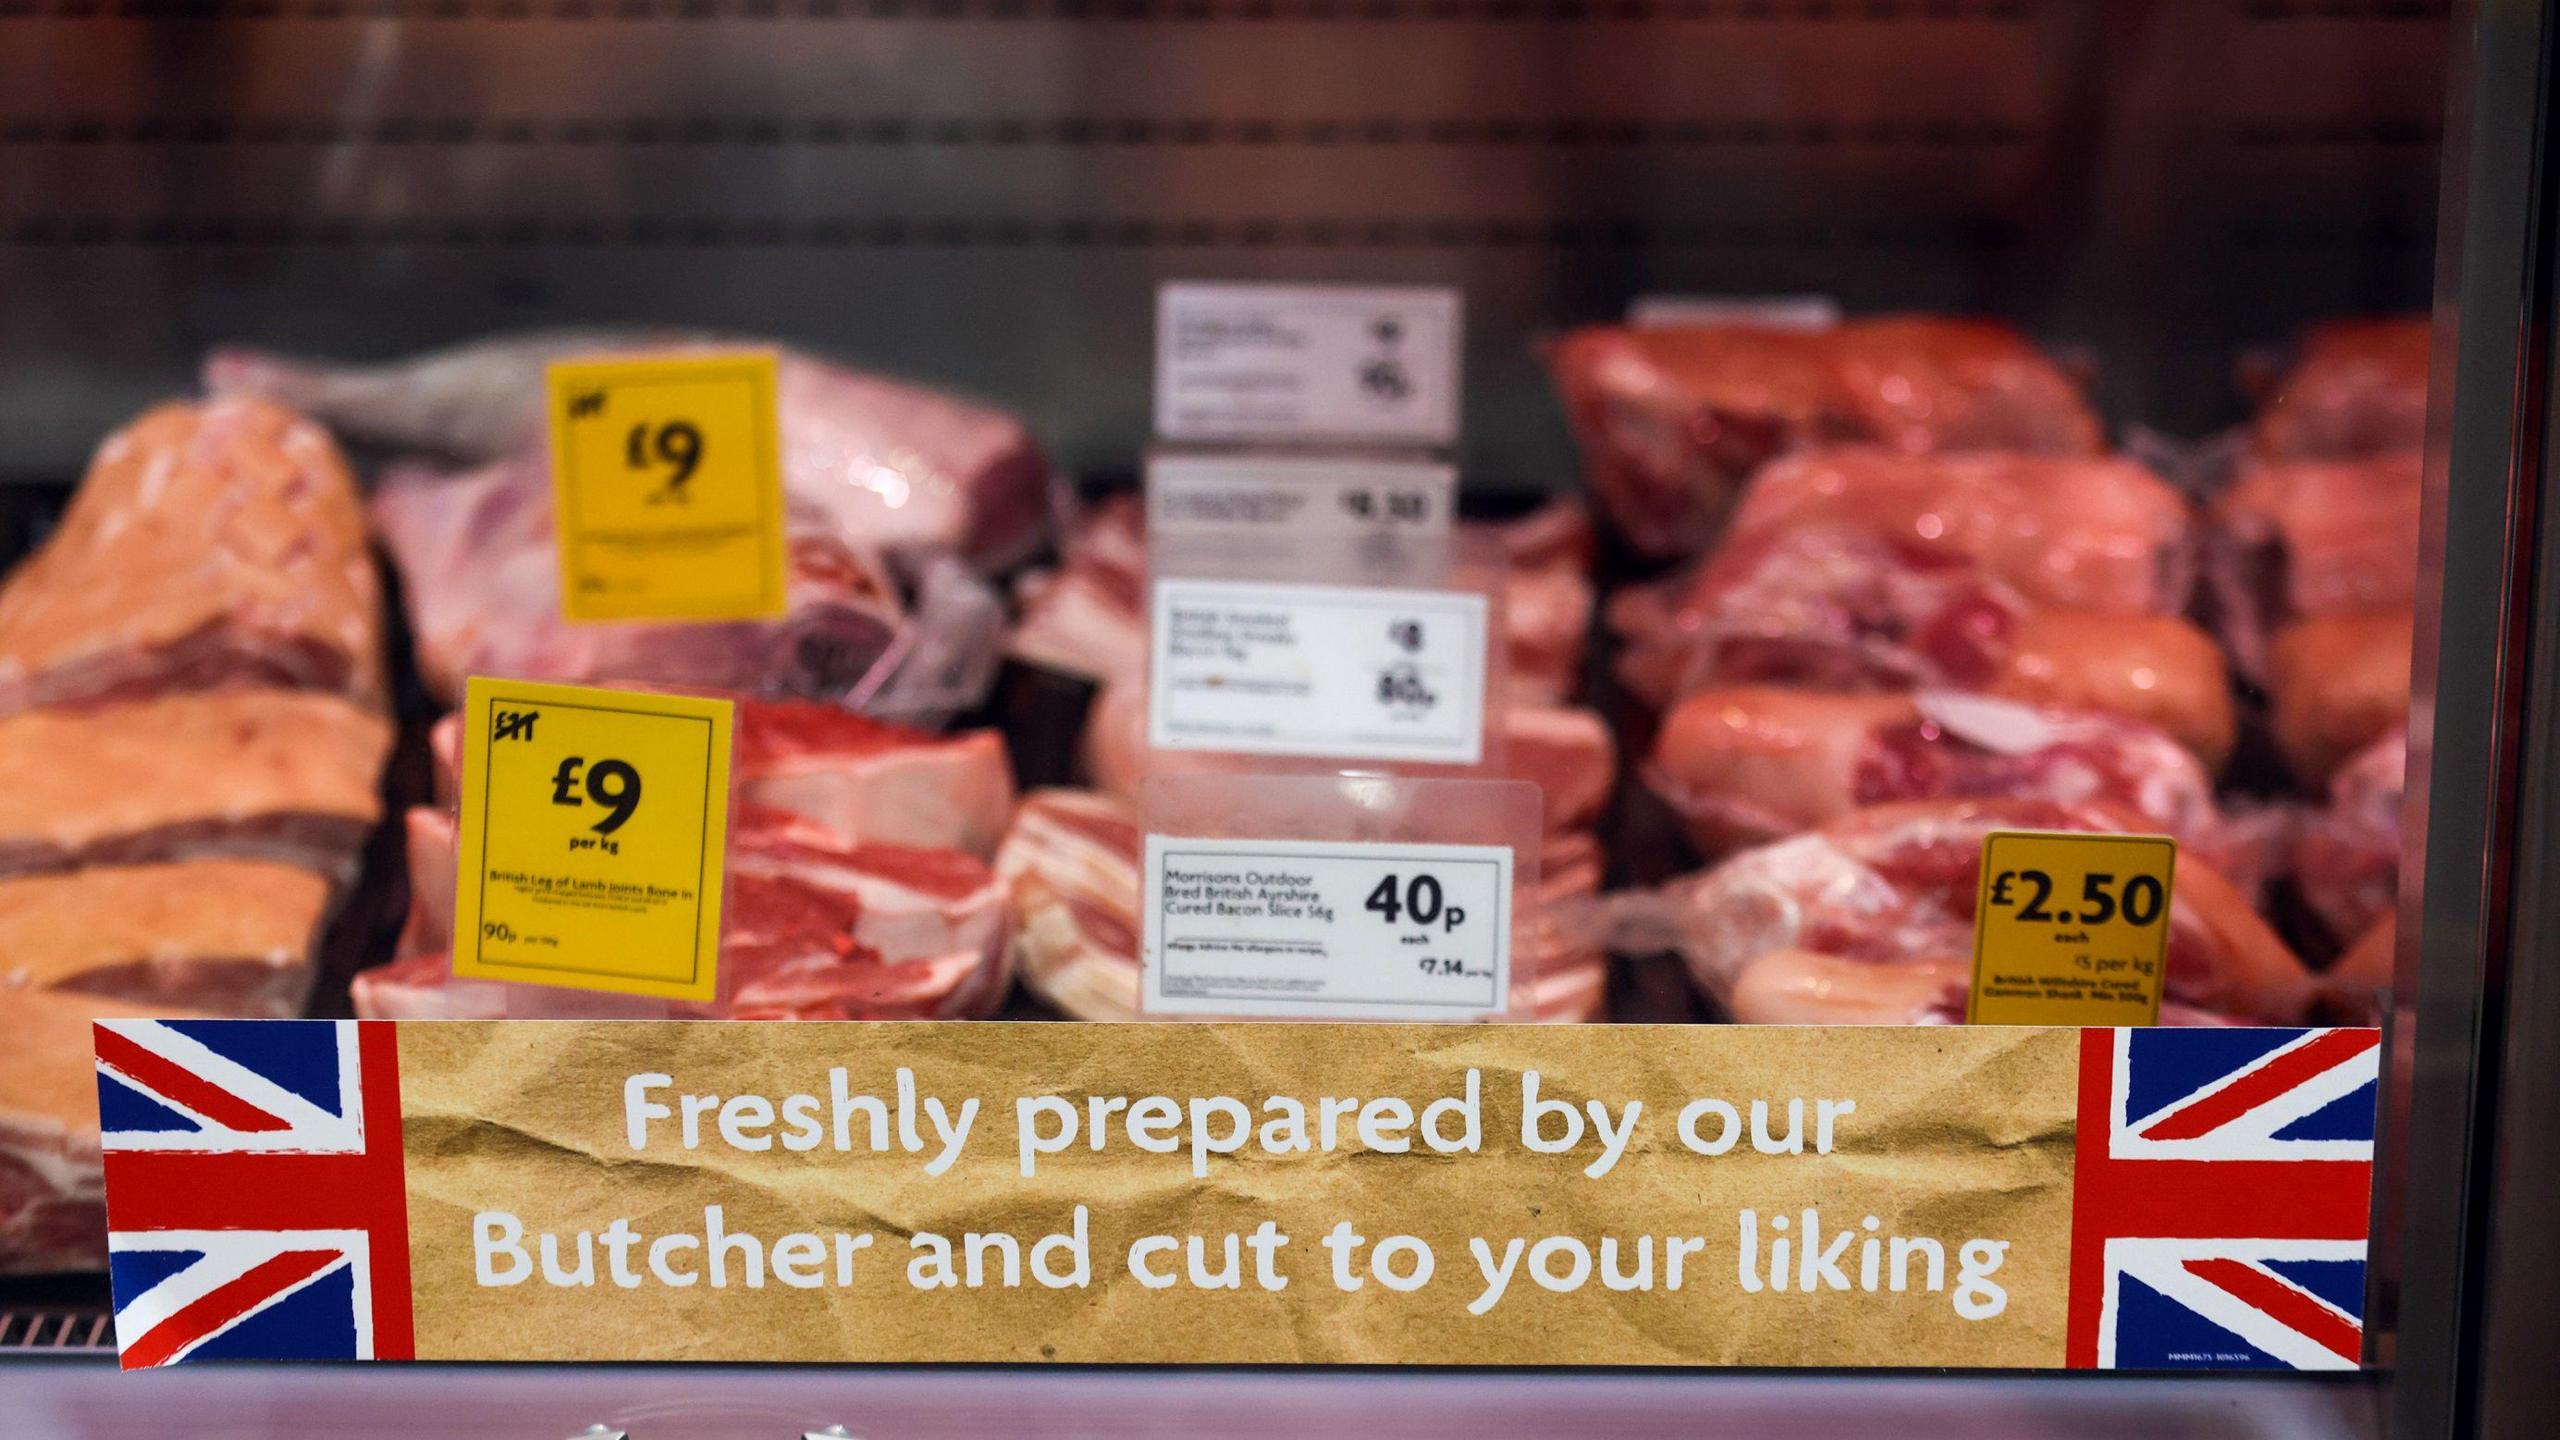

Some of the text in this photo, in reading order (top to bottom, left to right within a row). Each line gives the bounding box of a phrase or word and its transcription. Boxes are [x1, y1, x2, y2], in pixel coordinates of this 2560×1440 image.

[551, 756, 641, 835] £9
[570, 837, 619, 855] per kg
[489, 870, 528, 884] British
[531, 874, 552, 889] Leg
[555, 876, 570, 888] of
[573, 878, 606, 892] Lamb
[647, 885, 678, 899] Bone
[1166, 870, 1313, 887] Morrisons Outdoor
[1165, 885, 1320, 904] Bred British Ayrshire
[1364, 873, 1466, 933] 40p
[1990, 869, 2164, 927] £2.50
[1165, 901, 1212, 915] Cured
[1216, 902, 1263, 916] Bacon
[1268, 903, 1302, 918] Slice
[484, 922, 516, 944] 90p
[1400, 933, 1430, 945] each
[2054, 931, 2089, 944] each
[1420, 957, 1464, 976] £7.14
[2096, 959, 2127, 973] per
[2134, 955, 2154, 976] kg
[625, 1068, 1855, 1178] Freshly prepared by our
[474, 1206, 2009, 1320] Butcher and cut to your liking
